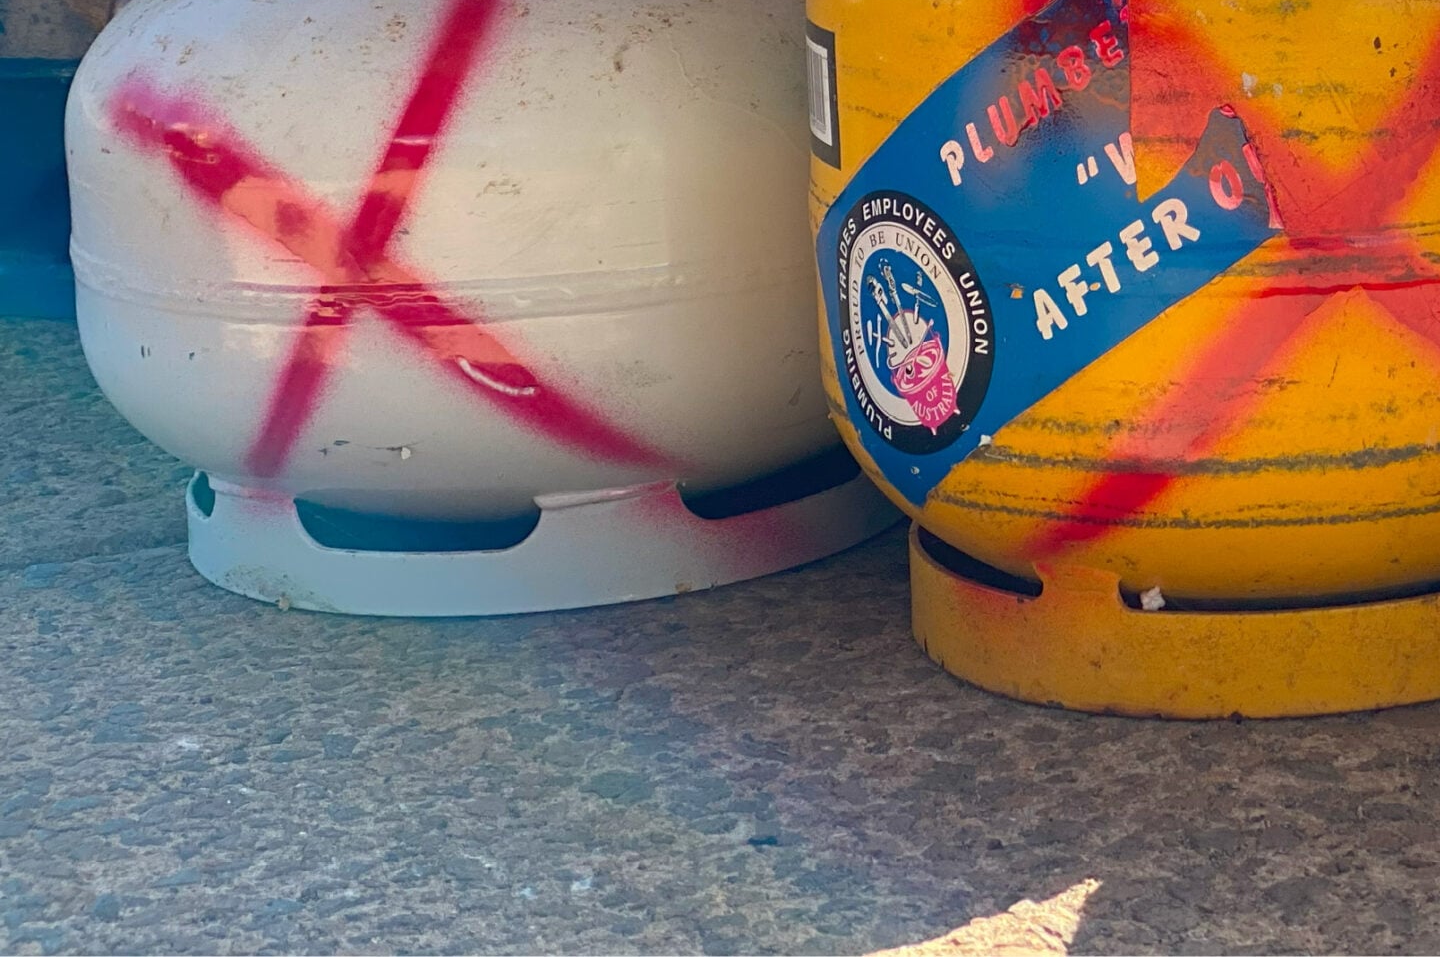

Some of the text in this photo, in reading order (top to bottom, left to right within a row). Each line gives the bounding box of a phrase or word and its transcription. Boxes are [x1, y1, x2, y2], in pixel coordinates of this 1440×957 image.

[854, 246, 866, 269] TO
[868, 230, 886, 249] BE
[894, 232, 943, 281] UNION
[1033, 198, 1201, 341] AFTER
[838, 197, 989, 441] PLUMBING TRADES EMPLOYEES UNION
[911, 373, 954, 422] AUSTRALIA
[925, 385, 940, 403] OF
